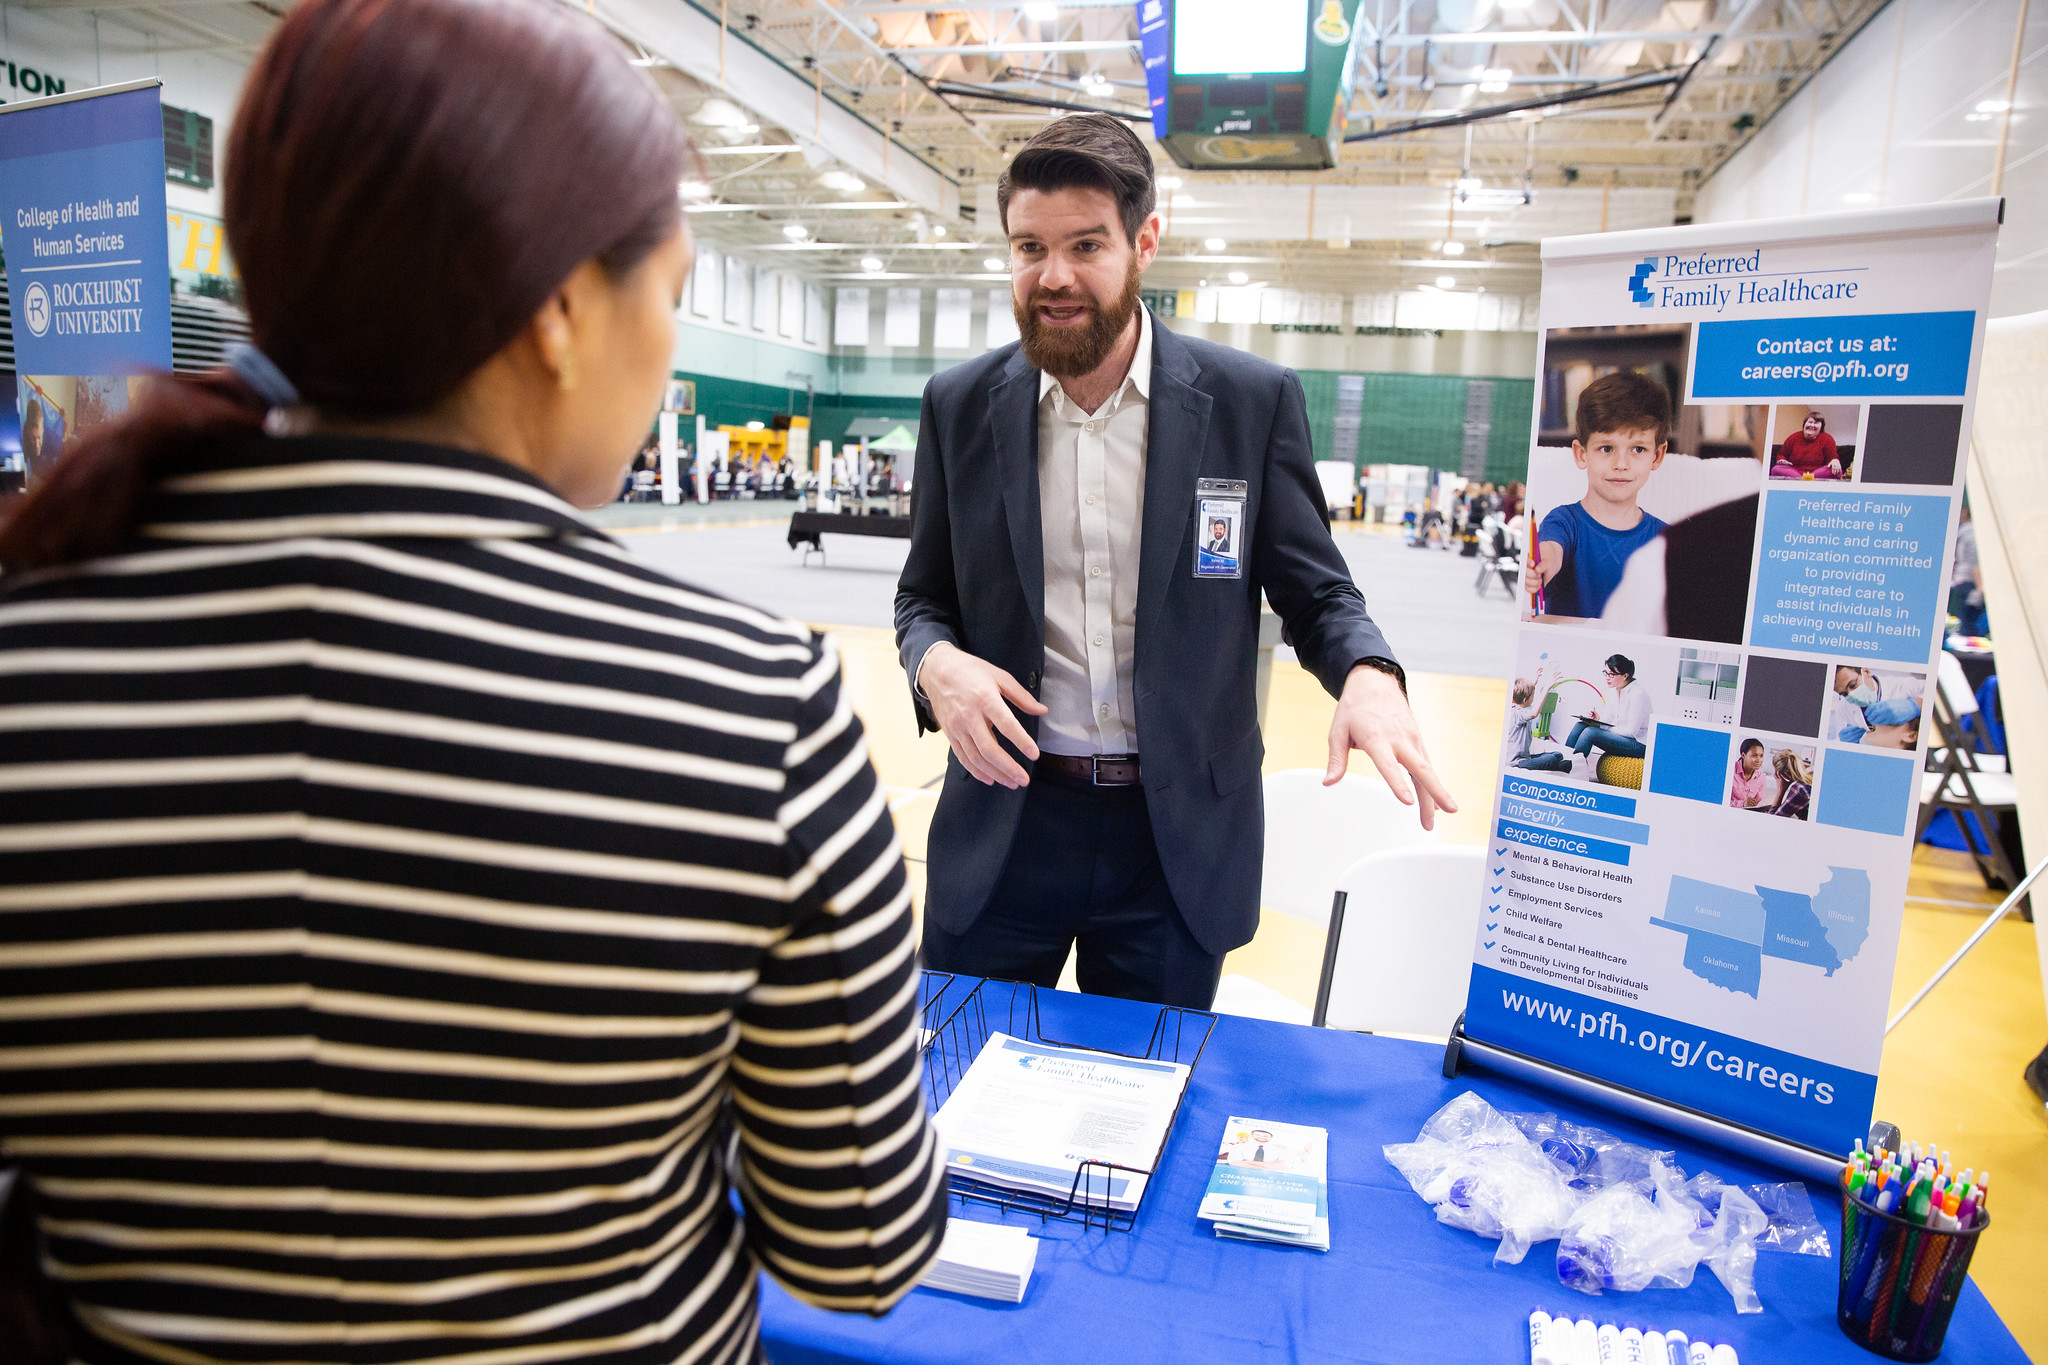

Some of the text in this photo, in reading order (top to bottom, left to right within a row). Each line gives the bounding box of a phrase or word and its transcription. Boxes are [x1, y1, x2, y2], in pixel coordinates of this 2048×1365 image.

[0, 59, 66, 97] ION
[17, 195, 140, 230] College of Health and
[33, 232, 124, 257] Human Services
[1664, 249, 1761, 277] Preferred
[53, 278, 142, 307] ROCKHURST
[1660, 278, 1858, 312] Family Healthcare
[55, 308, 143, 335] UNIVERSITY
[1756, 335, 1898, 355] Contact us at:
[1740, 360, 1909, 383] careers@pfh.org
[1798, 498, 1912, 518] Preferred Family
[1800, 515, 1904, 533] Healthcare is a
[1784, 531, 1919, 553] dynamic and caring
[1768, 549, 1933, 569] organization committed
[1804, 566, 1886, 586] to providing
[1784, 581, 1905, 602] integrated care to
[1776, 599, 1909, 619] assist individuals in
[1762, 613, 1921, 638] achieving overall health
[1791, 633, 1882, 651] and wellness.
[1509, 781, 1598, 809] compassion.
[1506, 802, 1566, 827] integrity.
[1504, 826, 1589, 854] experience.
[1512, 850, 1633, 885] Mental & Behavioral Health
[1510, 870, 1623, 904] Substance Use Disorders
[1508, 888, 1604, 919] Employment Services
[1695, 905, 1721, 918] Kansas
[1827, 909, 1855, 923] Illinois
[1506, 908, 1563, 930] Child Welfare
[1503, 926, 1628, 966] Medical & Dental Healthcare
[1776, 933, 1810, 948] Missouri
[1501, 944, 1649, 991] Community Living for Individuals
[1702, 956, 1739, 972] Oklahoma
[1500, 956, 1639, 1001] with Developmental Disabilities
[1502, 989, 1835, 1105] www.pfh.org/careers
[1625, 1338, 1641, 1364] PFH
